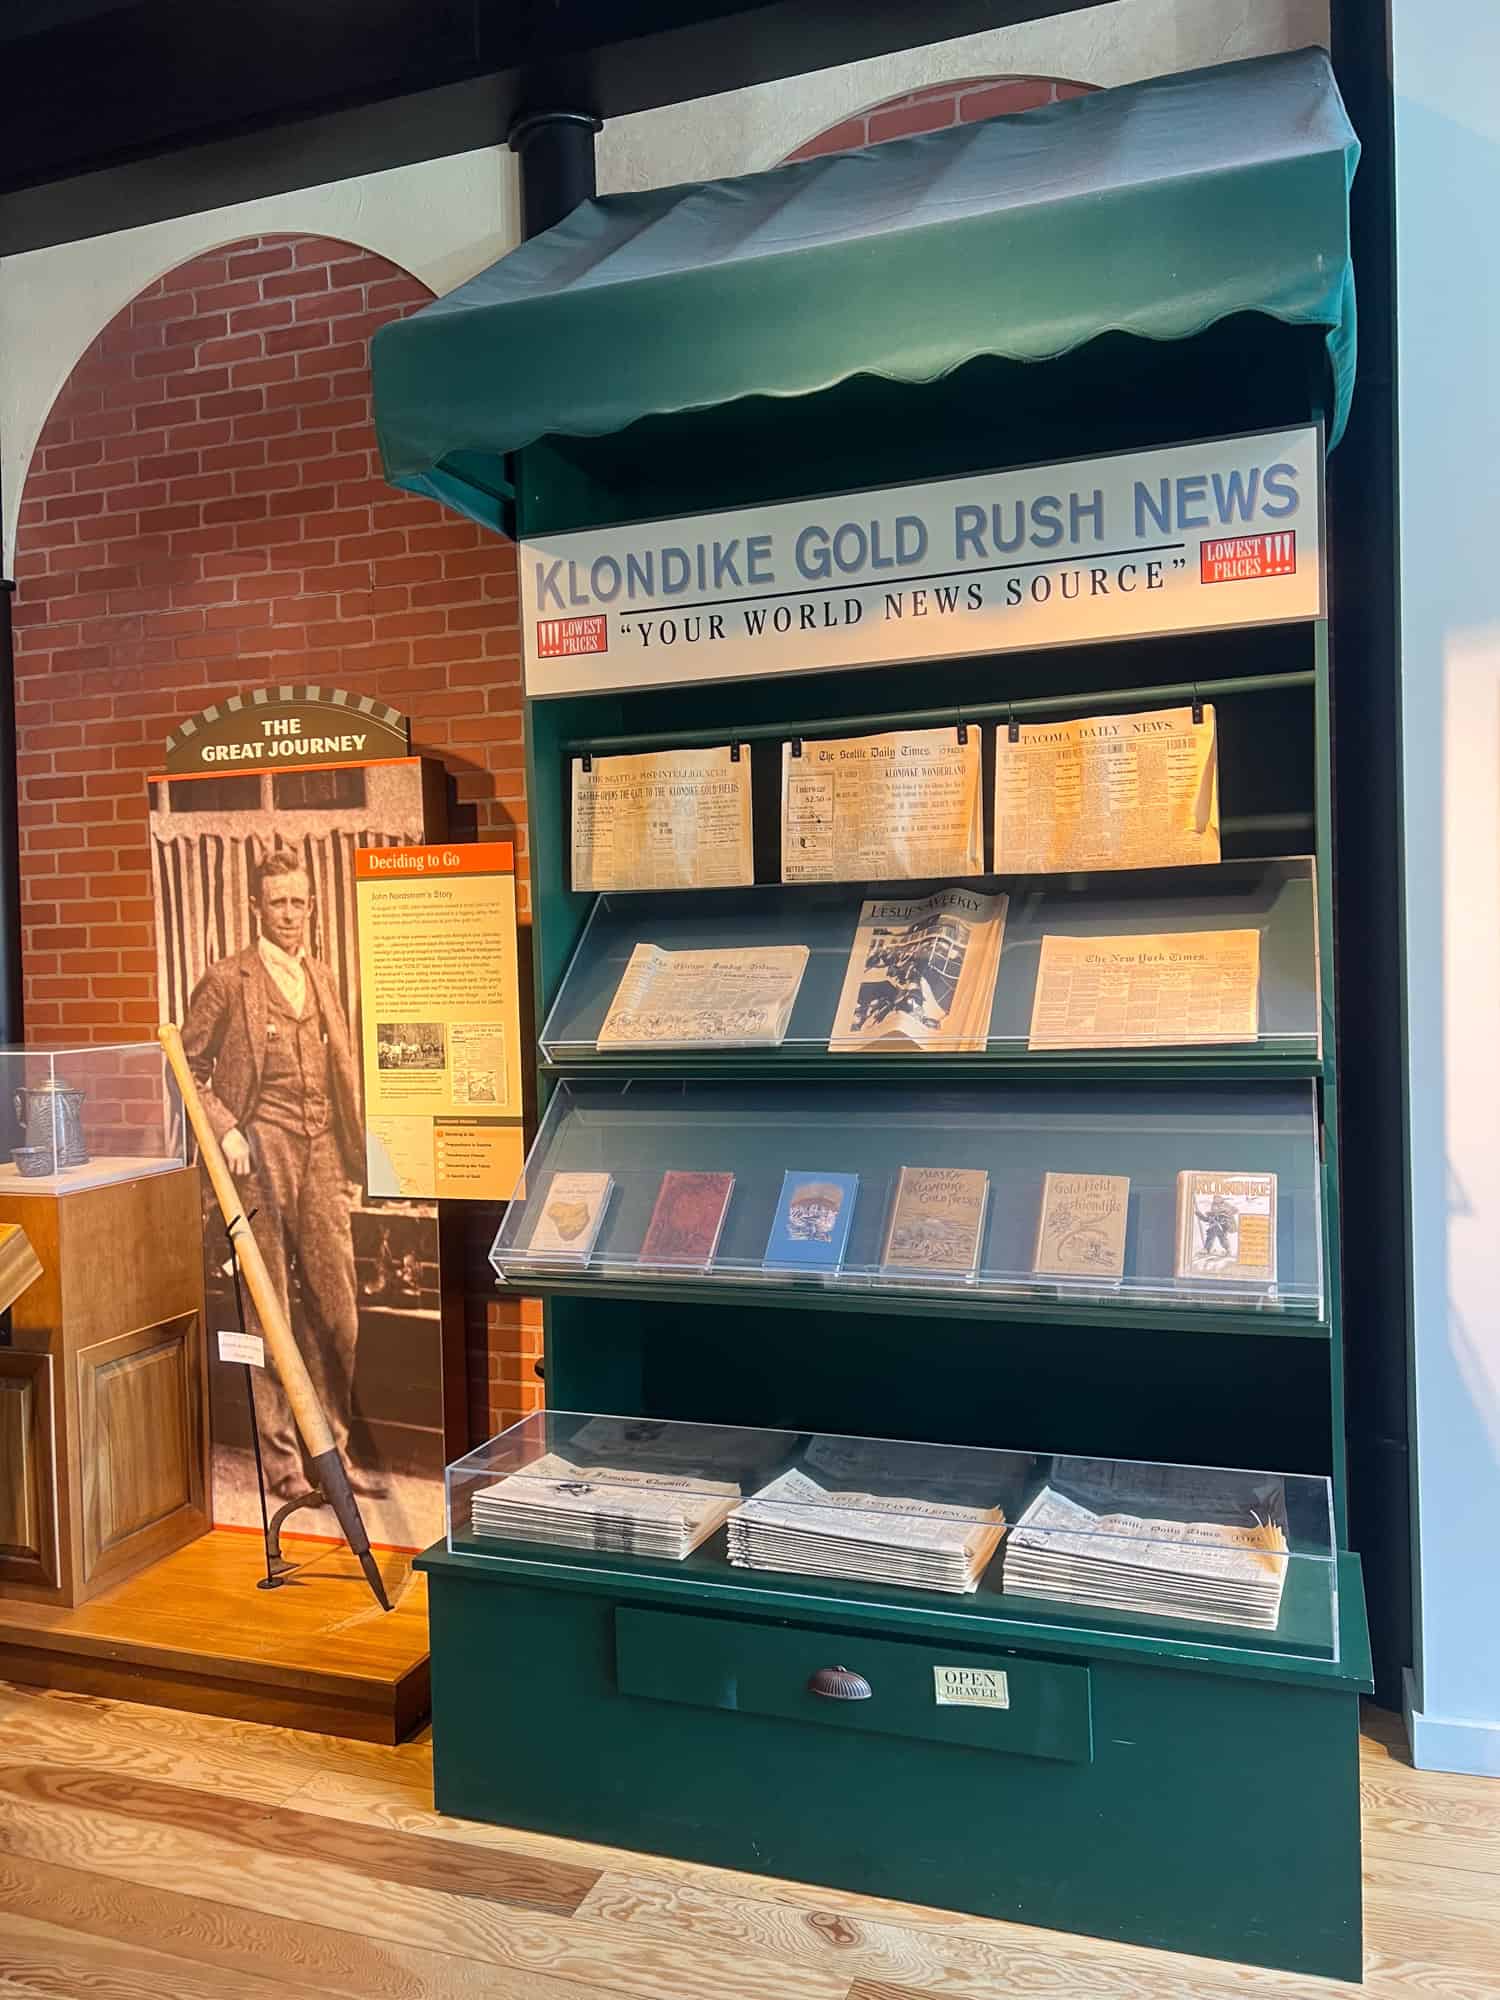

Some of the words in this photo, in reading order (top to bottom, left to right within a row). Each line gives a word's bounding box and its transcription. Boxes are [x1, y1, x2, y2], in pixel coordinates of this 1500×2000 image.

[535, 534, 776, 612] KLONDIKE
[795, 514, 929, 580] GOLD
[954, 487, 1105, 562] RUSH
[1133, 462, 1300, 539] NEWS
[1207, 538, 1261, 561] LOWEST
[1214, 557, 1261, 579] PRICES
[744, 598, 863, 637] WORLD
[885, 583, 983, 620] NEWS
[562, 618, 602, 638] LOWEST
[563, 634, 598, 654] PRICES
[261, 718, 302, 737] THE
[1022, 731, 1070, 745] TACOMA
[1079, 724, 1121, 739] DAILY
[201, 742, 265, 762] GREAT
[268, 734, 367, 757] JOURNEY
[818, 750, 835, 762] The
[870, 746, 896, 760] Daily
[369, 853, 425, 872] Deciding
[427, 854, 440, 867] to
[442, 850, 461, 866] Go
[1086, 953, 1105, 963] The
[1111, 953, 1135, 963] New
[944, 1670, 998, 1687] OPEN
[945, 1686, 998, 1698] DRAWER
